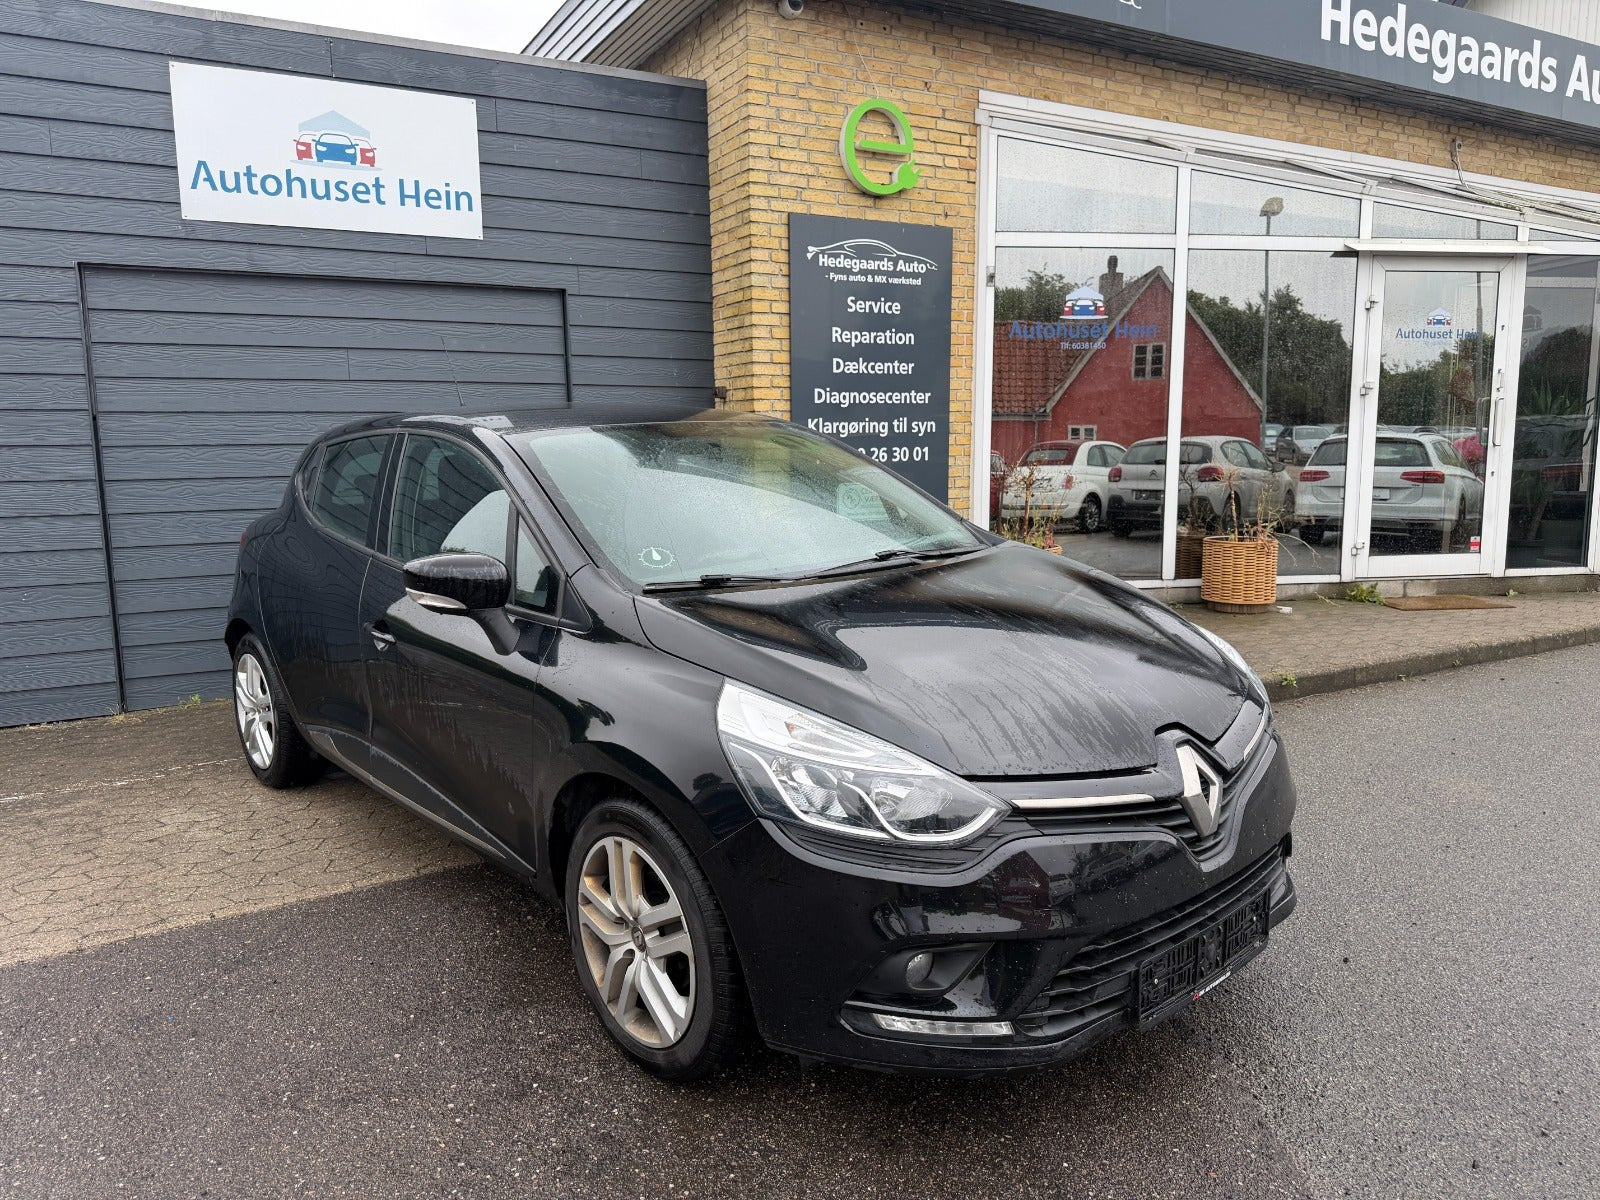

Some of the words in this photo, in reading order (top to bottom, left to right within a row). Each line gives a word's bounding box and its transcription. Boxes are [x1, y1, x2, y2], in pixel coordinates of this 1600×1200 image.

[1321, 0, 1558, 93] Hedegaards
[190, 160, 386, 205] Autohuset
[399, 178, 474, 212] Hein
[818, 254, 894, 272] Hedegaards
[896, 260, 927, 273] Auto
[829, 272, 847, 282] Fyns
[867, 275, 873, 283] &
[874, 275, 887, 283] MX
[888, 276, 922, 285] værksted
[847, 296, 901, 314] Service
[831, 327, 915, 347] Reparation
[1009, 320, 1109, 339] Autohuset
[1115, 321, 1157, 339] Hein
[1395, 328, 1453, 339] Autohuset
[832, 357, 915, 375] Dækcenter
[814, 387, 932, 408] Diagnosecenter
[807, 417, 889, 438] Klargøring
[892, 417, 908, 433] til
[911, 420, 936, 436] syn
[870, 447, 888, 462] 26
[891, 447, 909, 462] 30
[913, 446, 929, 461] 01
